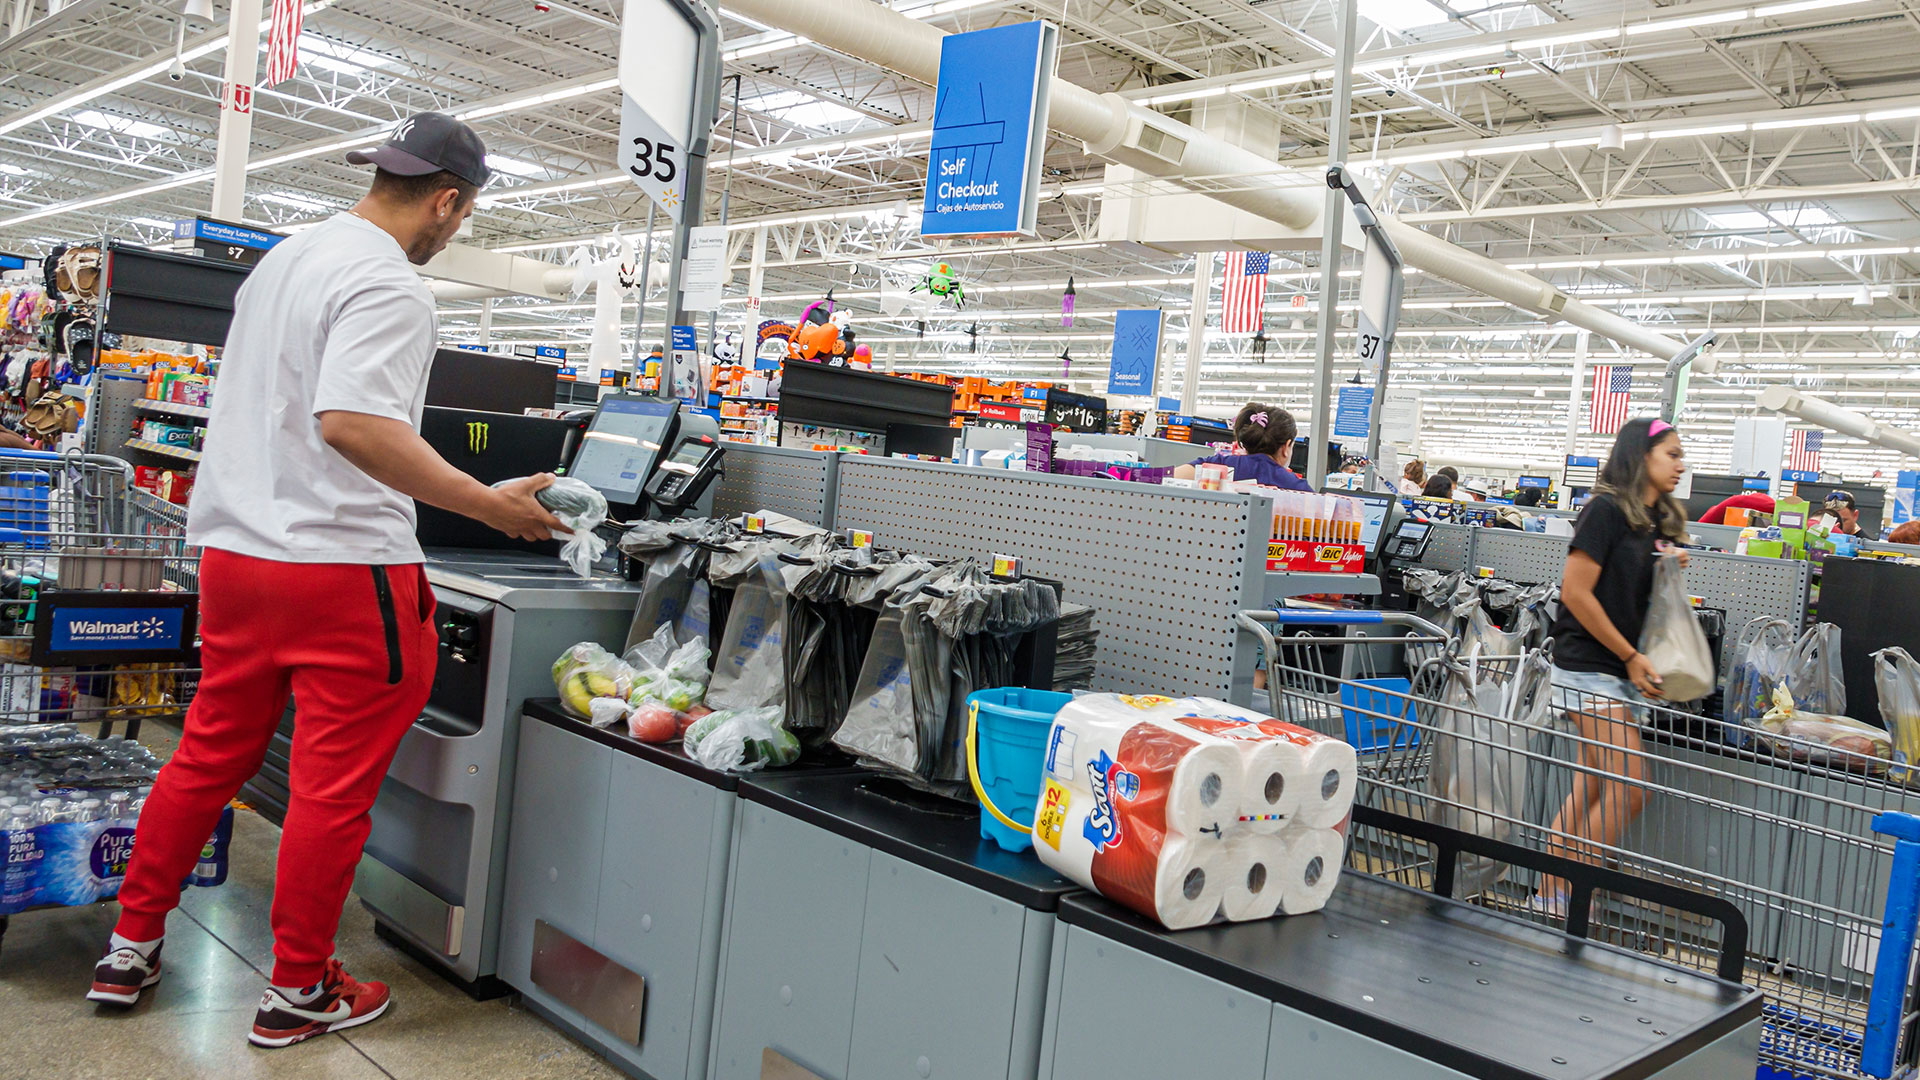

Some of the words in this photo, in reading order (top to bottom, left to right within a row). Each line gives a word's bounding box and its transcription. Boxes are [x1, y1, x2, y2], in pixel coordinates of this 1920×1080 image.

[630, 137, 676, 183] 35
[940, 157, 966, 176] Self
[938, 181, 998, 199] Checkout
[936, 203, 953, 213] Cajas
[954, 203, 963, 211] de
[964, 201, 1004, 211] Autoservicio
[202, 223, 235, 237] Everyday
[235, 229, 250, 238] Low
[250, 232, 268, 242] Price
[228, 246, 245, 259] $7
[1361, 334, 1380, 360] 37
[1114, 372, 1141, 380] Seasonal
[1030, 390, 1038, 398] F1
[70, 620, 140, 634] Walmart
[1046, 786, 1061, 809] 12
[1087, 763, 1113, 838] Scott
[1045, 811, 1054, 840] DOUBLE
[9, 843, 35, 854] PURA
[100, 833, 137, 848] Pure
[103, 846, 132, 864] Life
